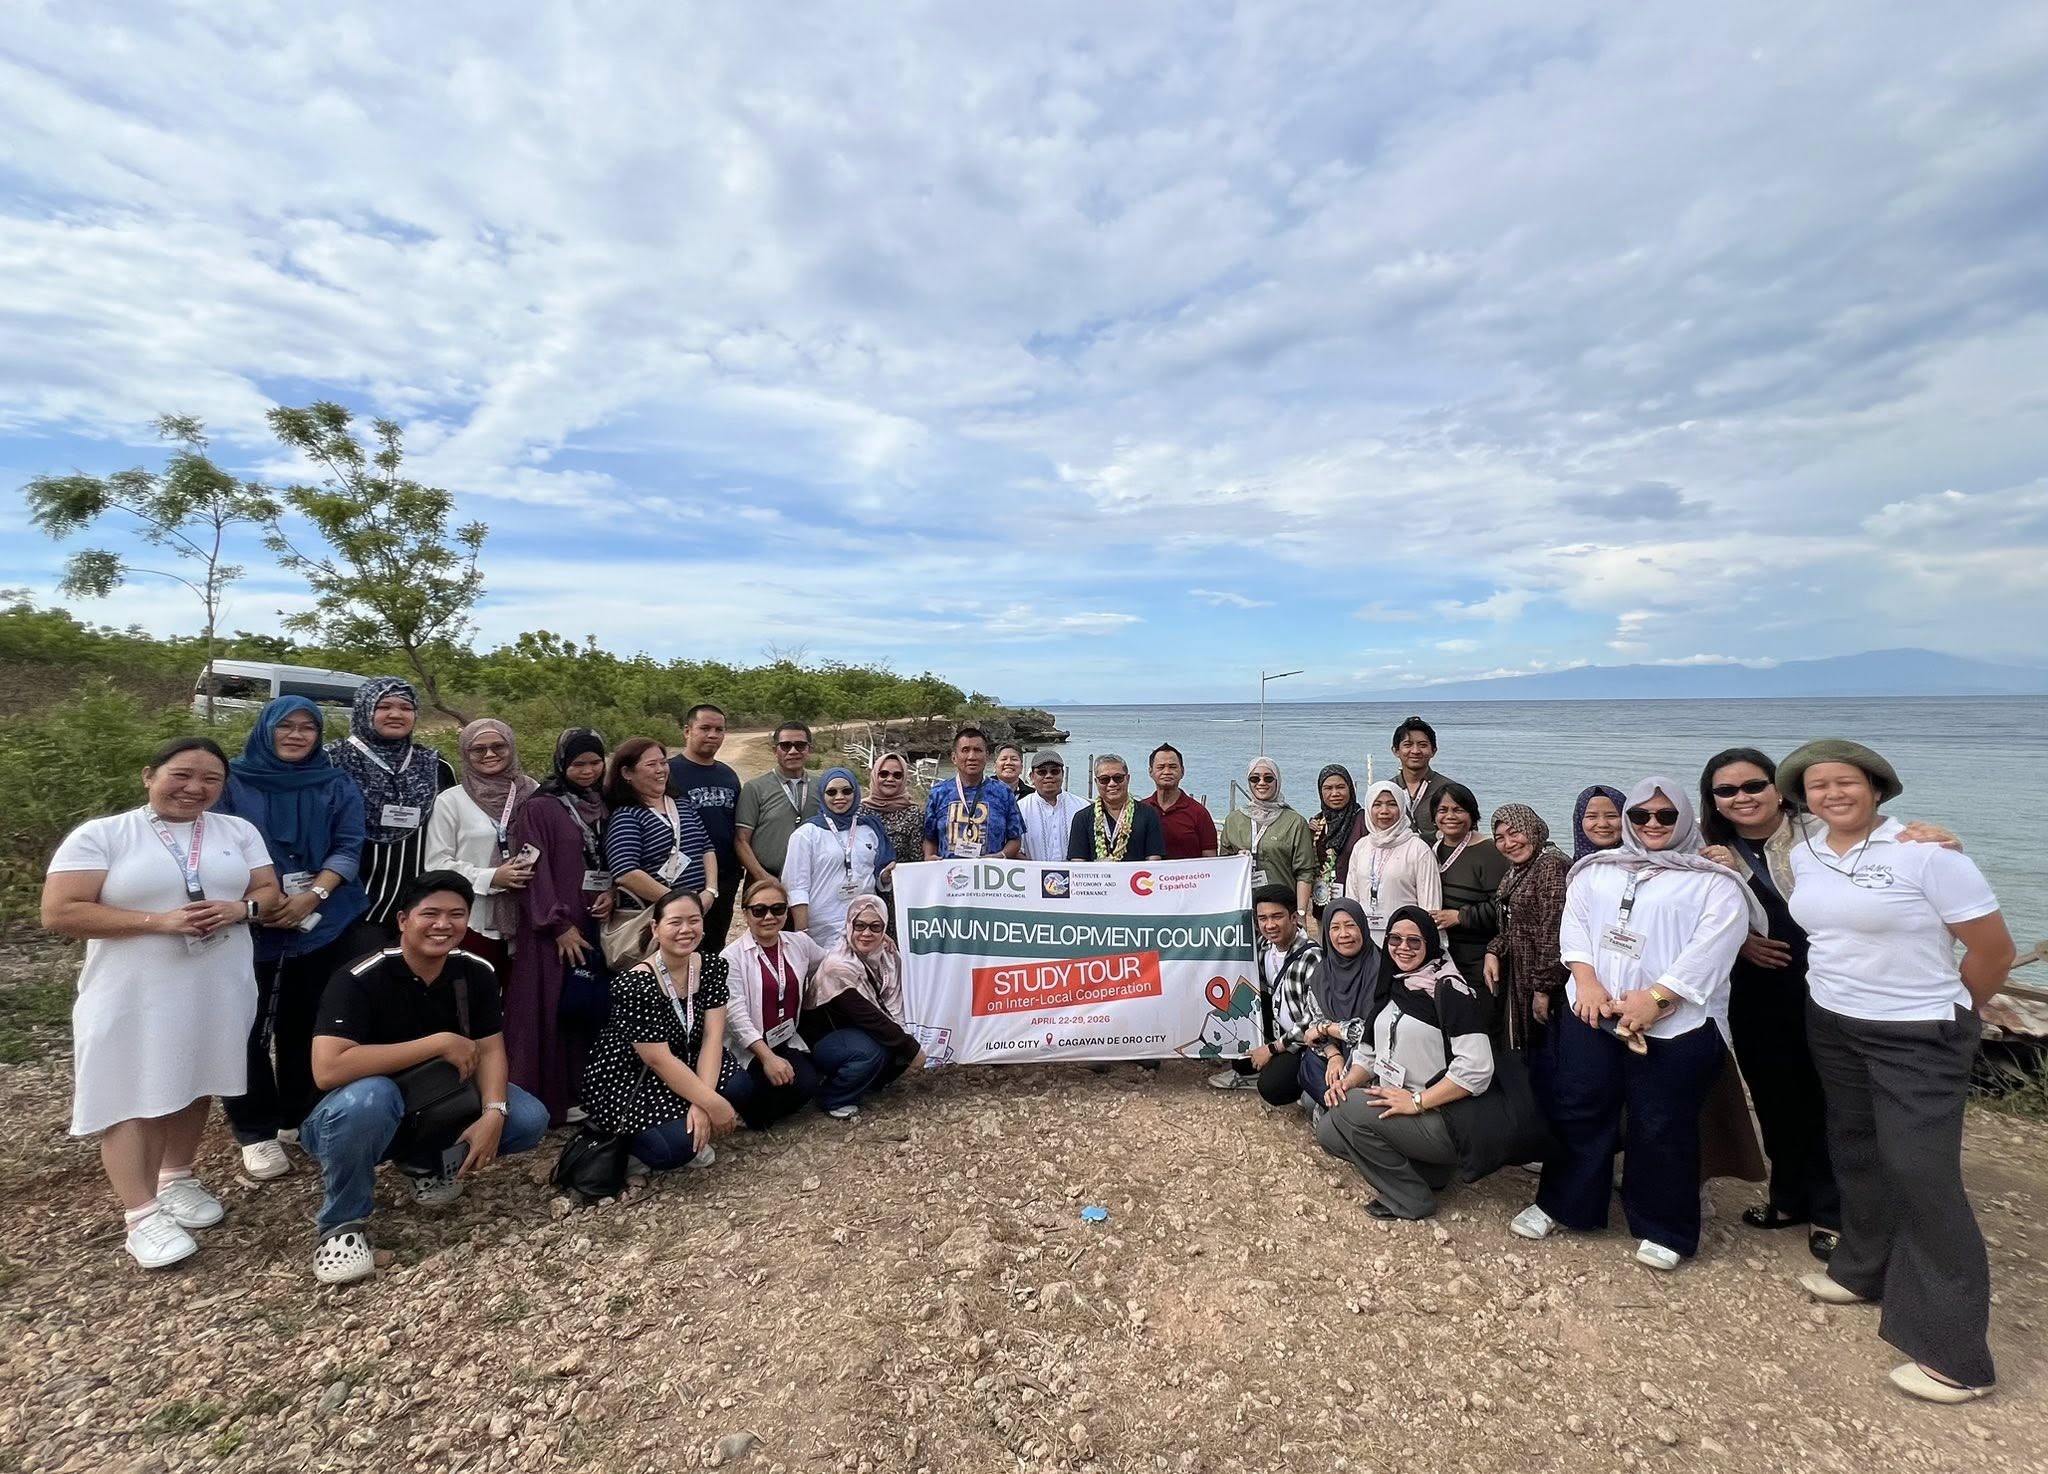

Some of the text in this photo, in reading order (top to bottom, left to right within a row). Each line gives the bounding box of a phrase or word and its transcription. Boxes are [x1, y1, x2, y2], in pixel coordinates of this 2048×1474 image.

[973, 864, 1026, 892] IDC
[1159, 881, 1197, 891] Española
[911, 917, 1251, 948] IRANUN DEVELOPMENT COUNCIL
[993, 956, 1142, 996] STUDY TOUR
[987, 981, 1152, 1012] on Inter-Local Cooperation
[1031, 1015, 1111, 1026] APRIL 22-29, 2026
[985, 1040, 1040, 1051] ILOILO CITY
[1058, 1035, 1167, 1047] CAGAYAN DE ORO CITY
